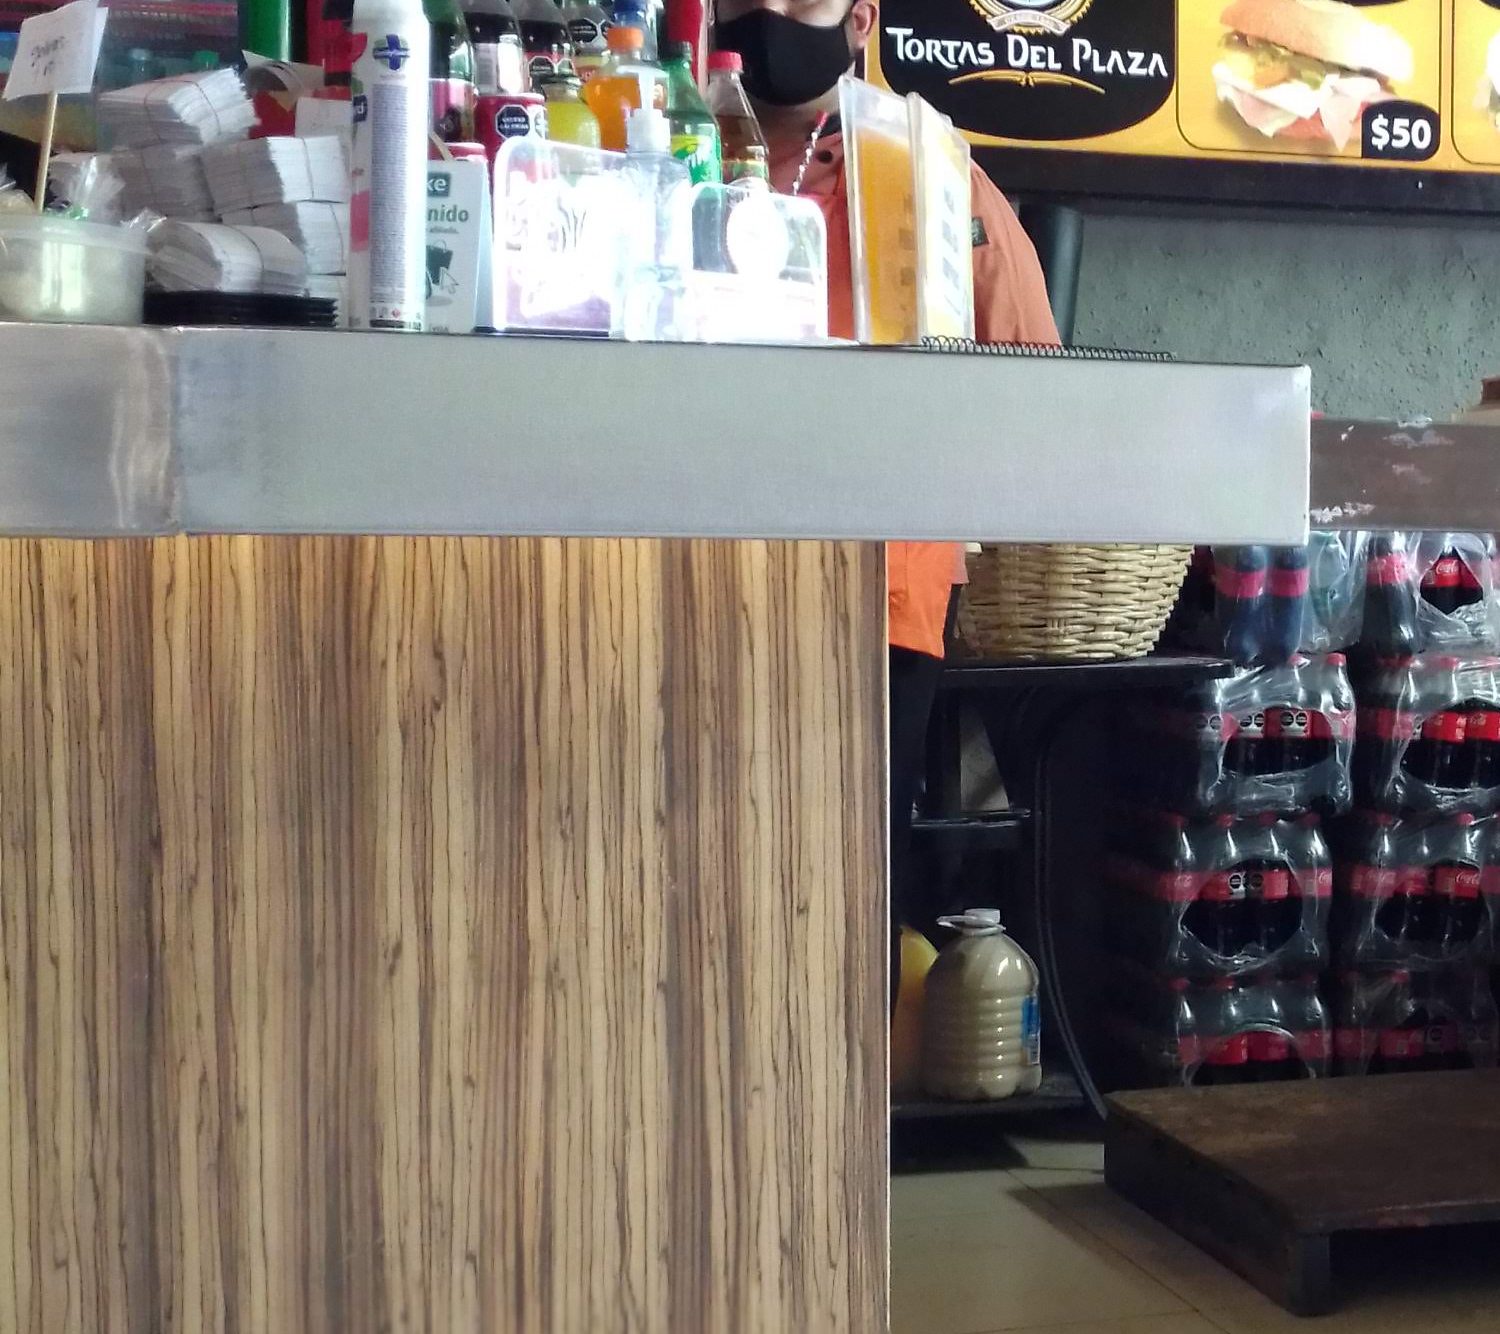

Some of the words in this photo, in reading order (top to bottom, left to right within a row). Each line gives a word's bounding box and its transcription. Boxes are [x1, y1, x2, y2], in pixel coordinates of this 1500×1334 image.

[886, 27, 994, 68] TORTAS
[1007, 33, 1061, 70] DEL
[1072, 38, 1168, 77] PLAZA
[1371, 116, 1432, 151] $50
